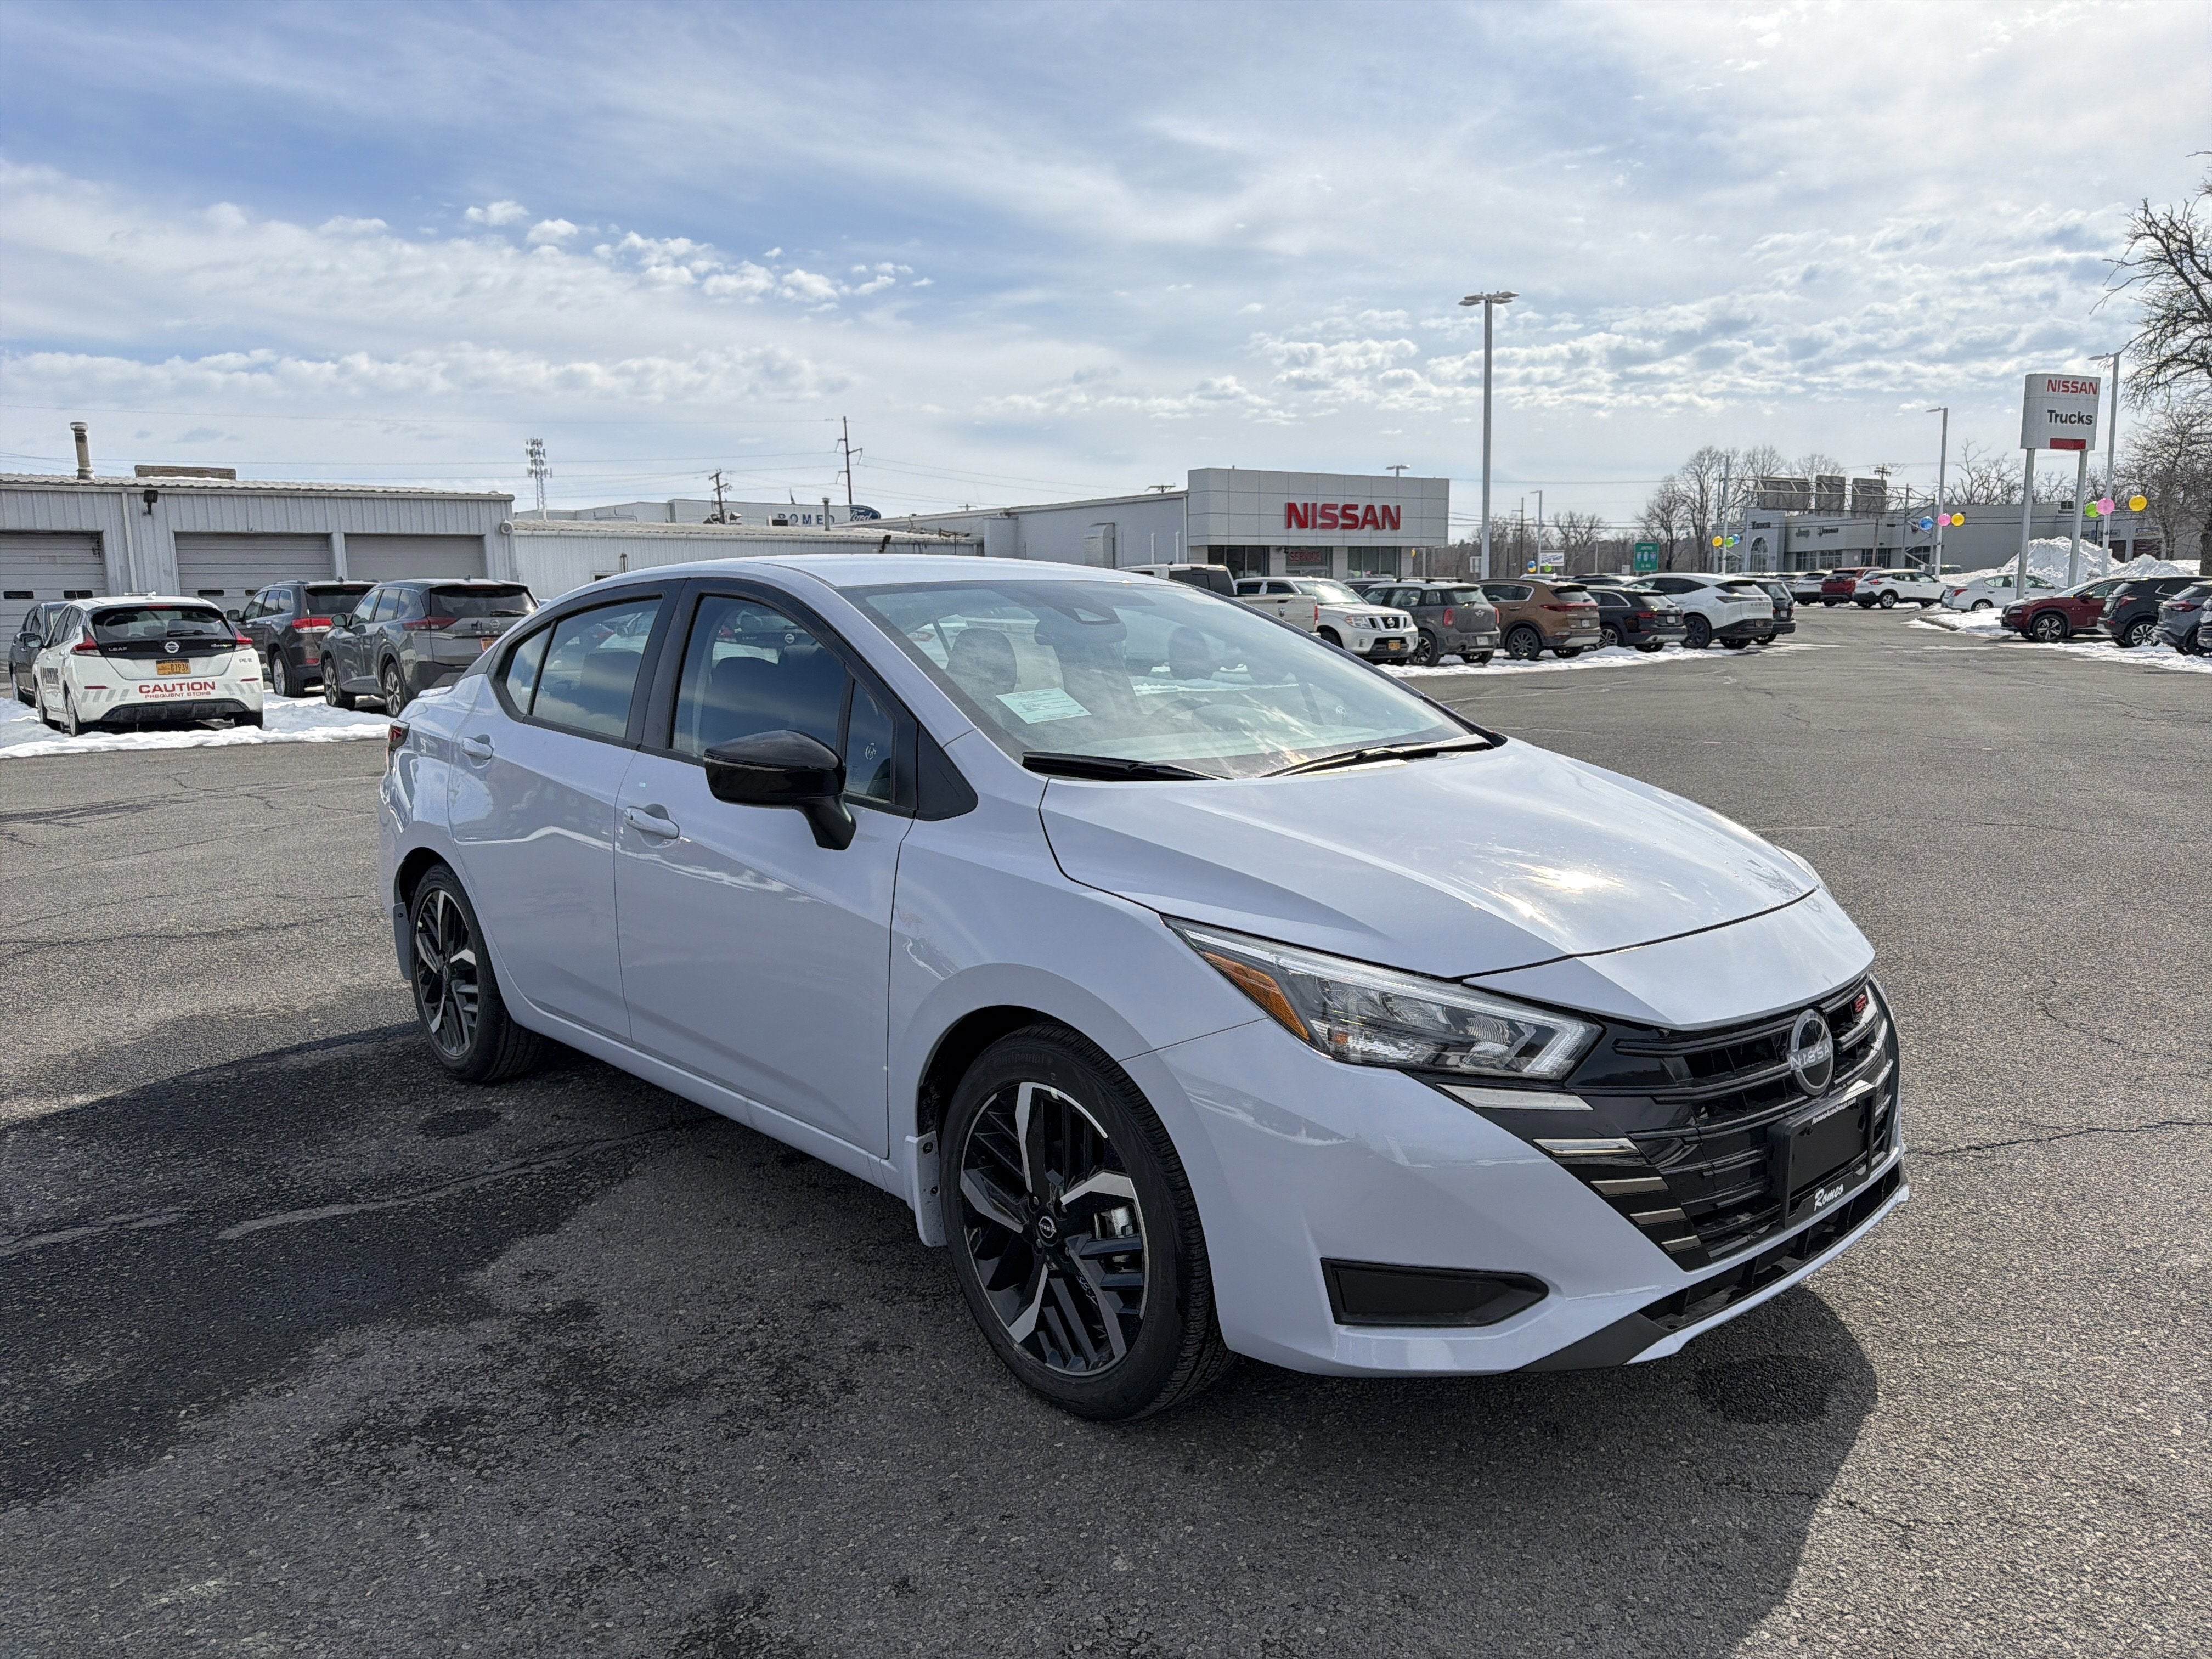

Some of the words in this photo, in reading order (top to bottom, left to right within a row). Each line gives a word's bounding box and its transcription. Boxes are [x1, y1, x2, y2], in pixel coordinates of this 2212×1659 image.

[2047, 379, 2098, 395] NISSAN
[2047, 409, 2094, 425] Trucks
[1286, 502, 1401, 530] NISSAN
[1290, 550, 1322, 562] SERVICE
[138, 681, 216, 693] CAUTION
[1854, 994, 1866, 1013] SR
[1814, 1184, 1844, 1212] Romeo
